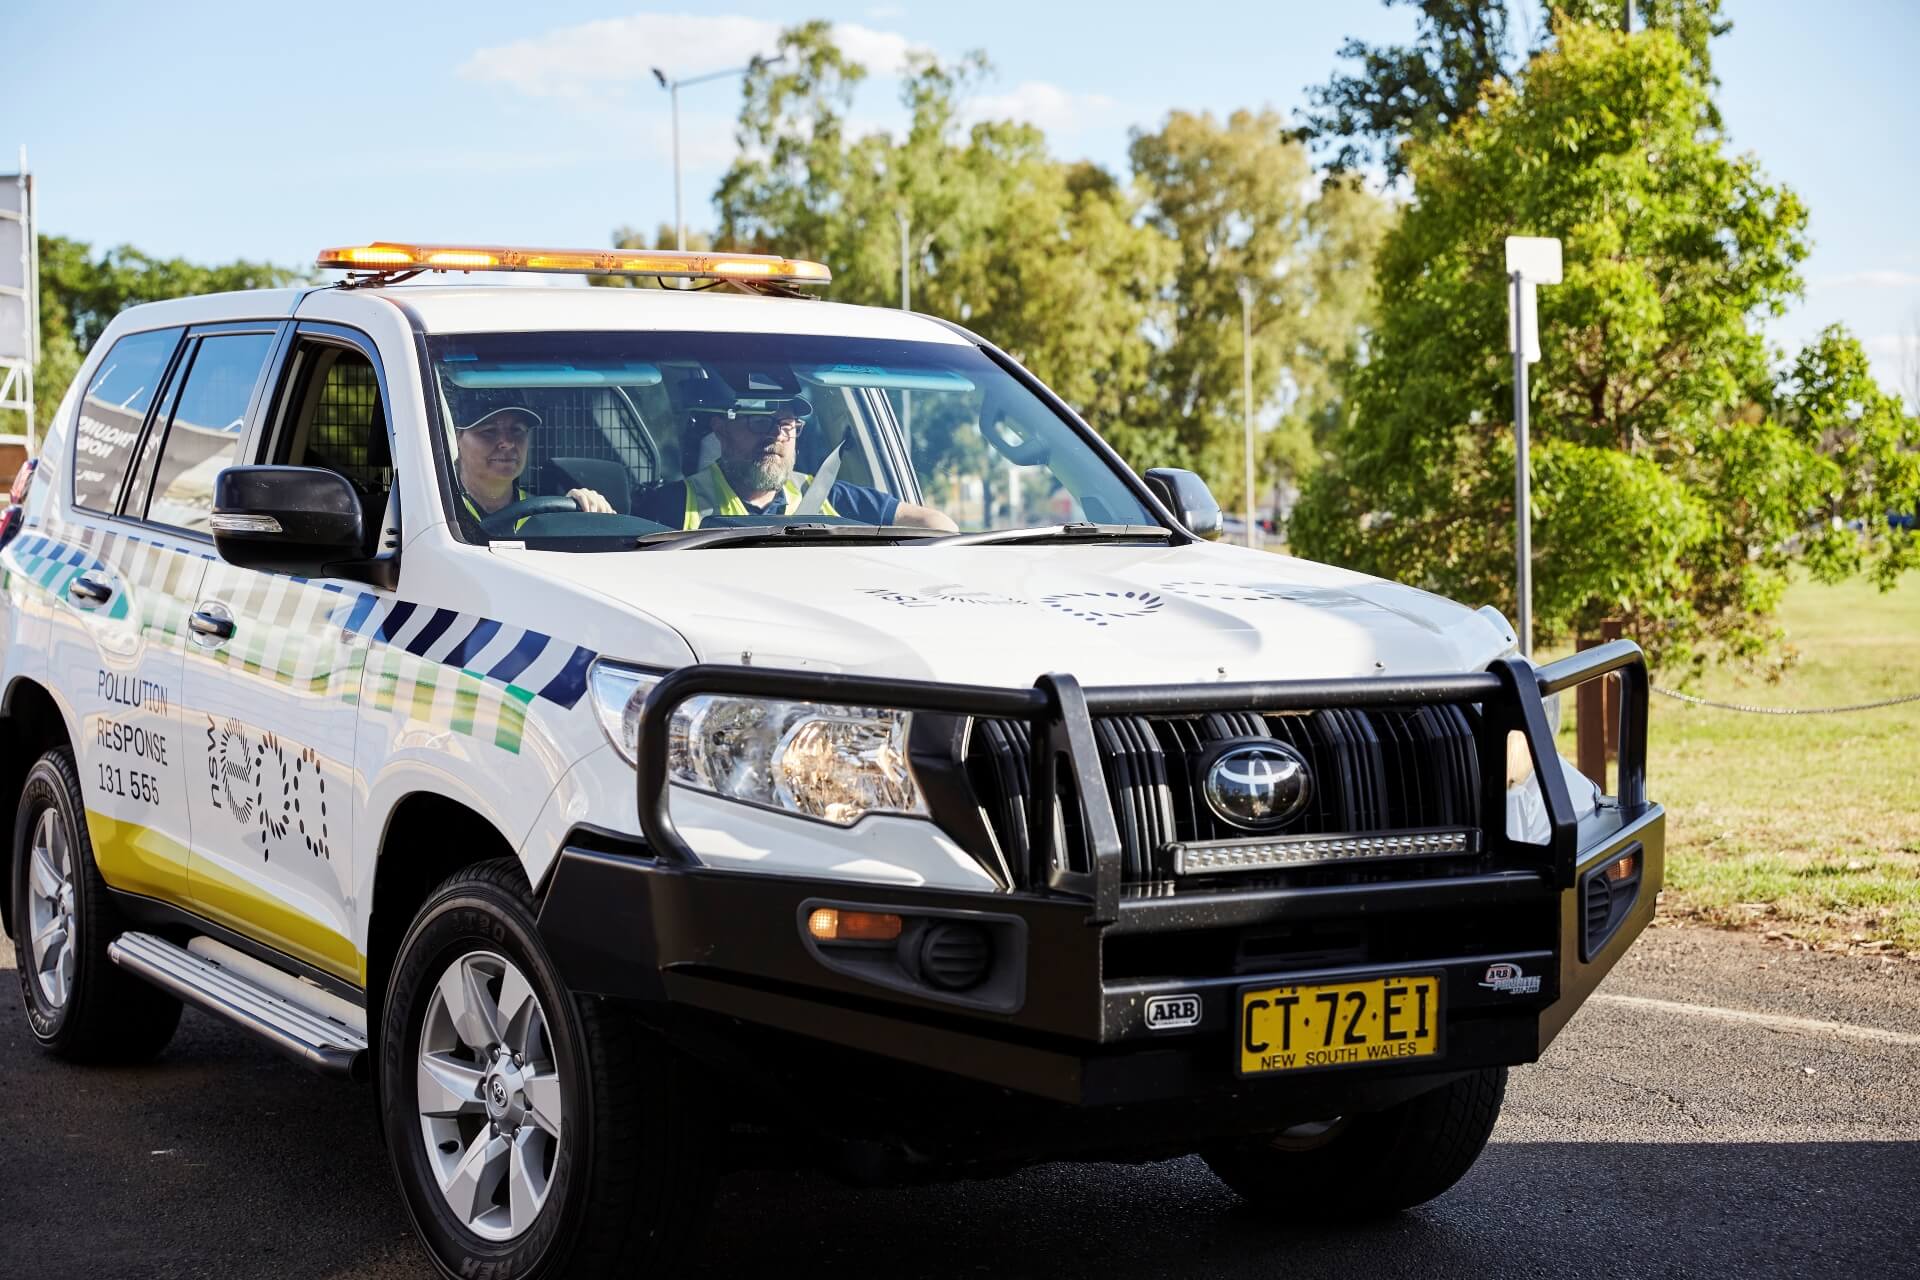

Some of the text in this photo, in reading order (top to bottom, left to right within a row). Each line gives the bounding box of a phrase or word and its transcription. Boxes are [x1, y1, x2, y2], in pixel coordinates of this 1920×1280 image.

[97, 669, 168, 717] POLLUTION
[97, 717, 168, 767] RESPONSE
[98, 762, 160, 806] 131 555
[1488, 969, 1509, 979] ARB
[1152, 1001, 1196, 1021] ARB
[1244, 985, 1430, 1054] CT 72 EI
[1261, 1041, 1418, 1069] NEW SOUTH WALES
